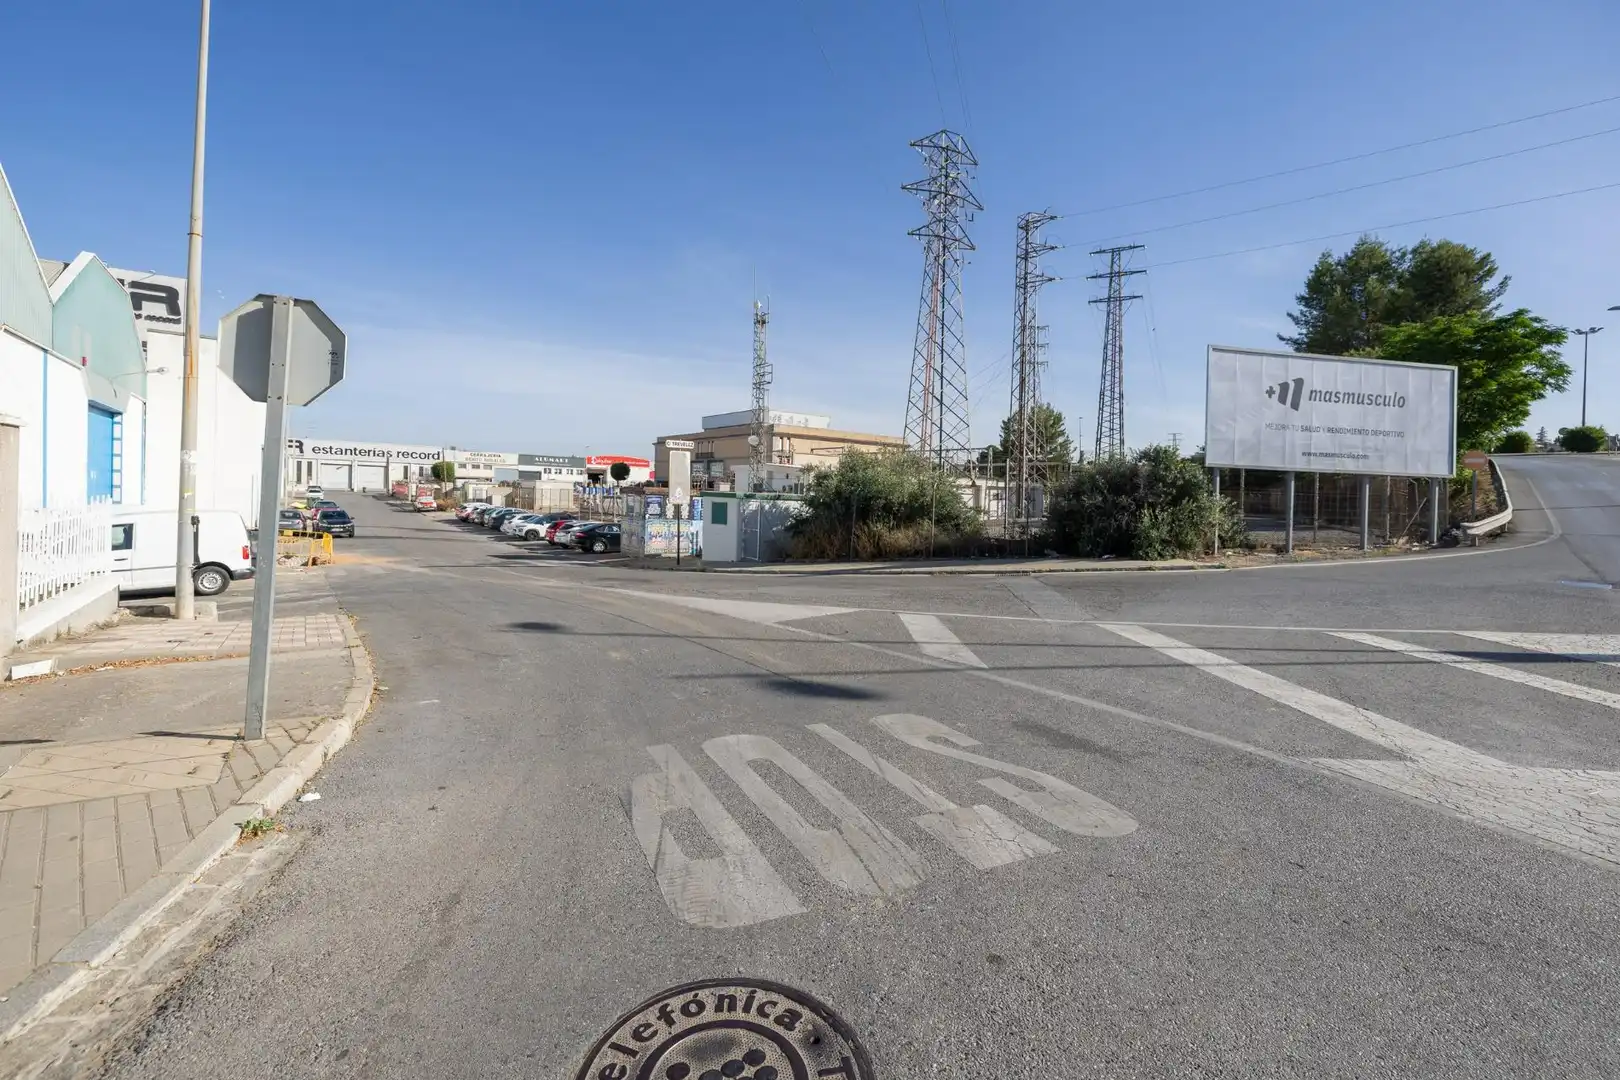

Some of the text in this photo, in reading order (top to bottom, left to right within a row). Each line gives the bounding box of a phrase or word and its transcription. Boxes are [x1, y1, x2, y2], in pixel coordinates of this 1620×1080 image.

[1308, 388, 1406, 408] masmusculo
[1265, 422, 1289, 432] MEJORA
[1291, 424, 1299, 432] TU
[1300, 425, 1320, 433] SALUD
[1327, 426, 1370, 436] RENDIMIENTO
[1370, 429, 1404, 438] DEPORTIVO
[396, 450, 440, 460] record
[1301, 451, 1370, 460] www.masmusculo.com
[629, 712, 1140, 930] STOP
[598, 988, 803, 1080] elefónica
